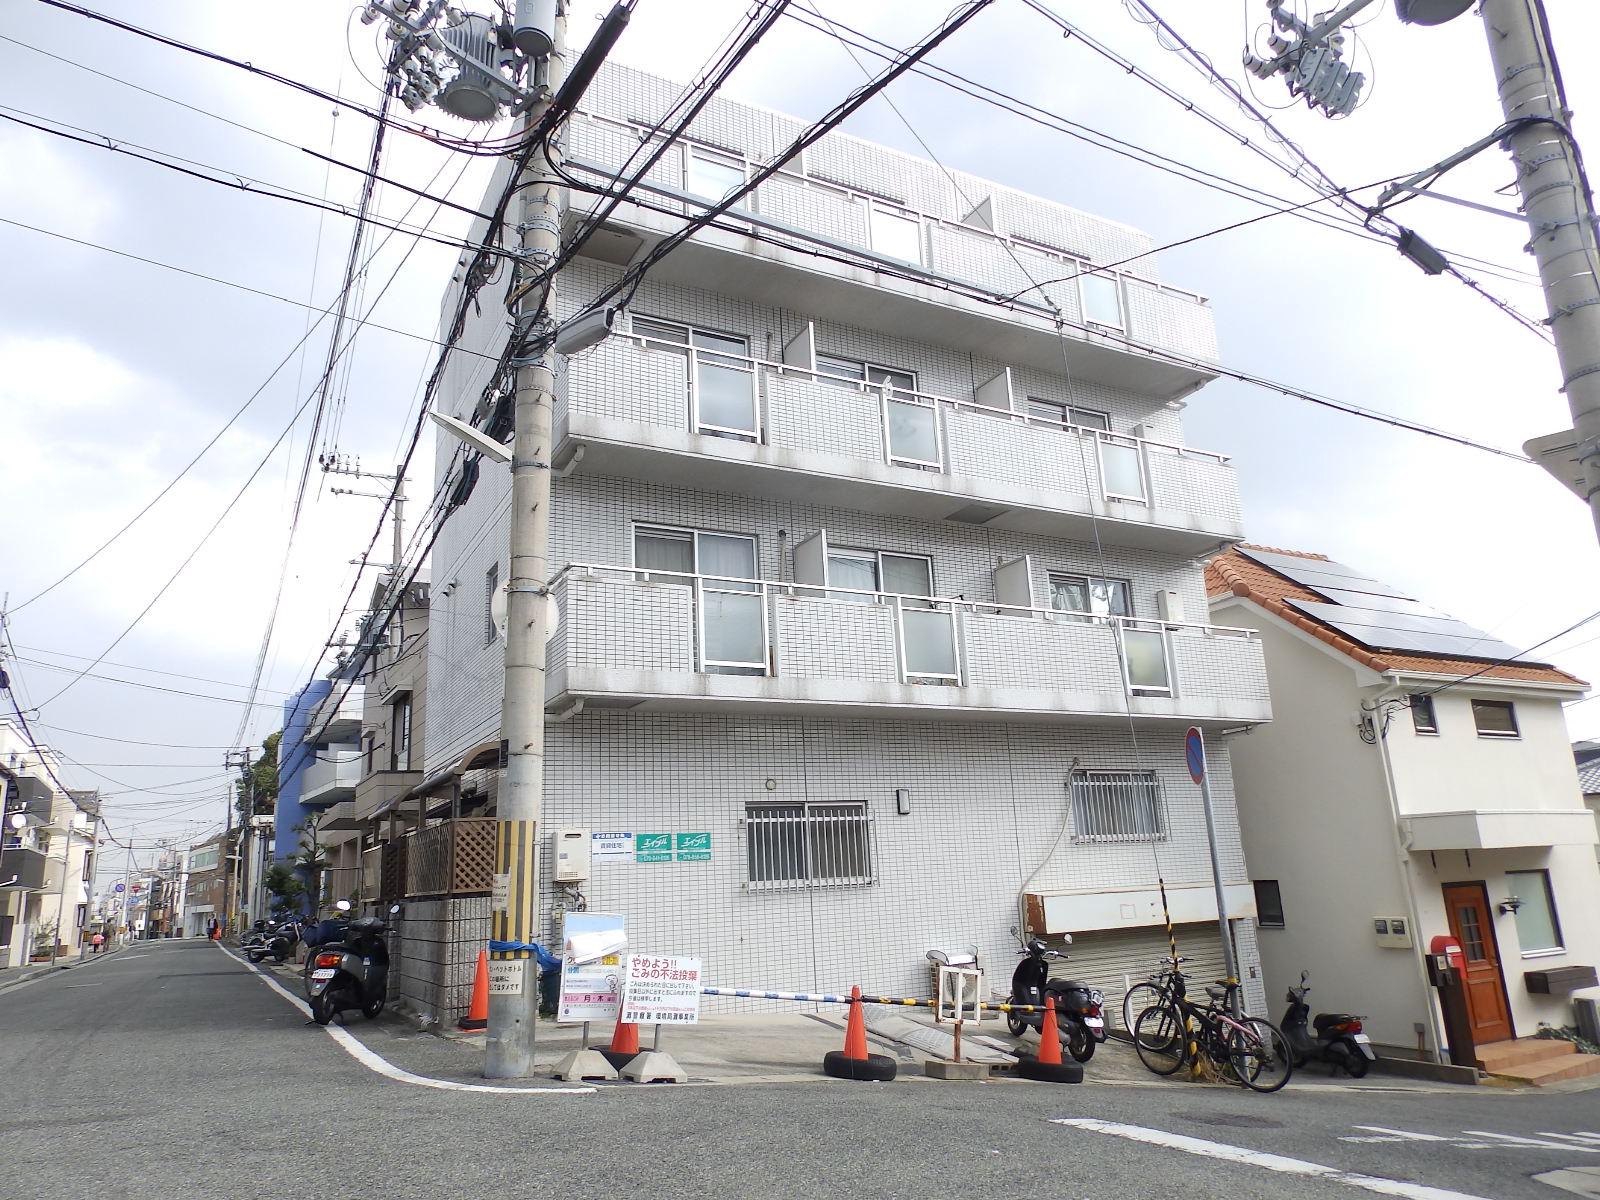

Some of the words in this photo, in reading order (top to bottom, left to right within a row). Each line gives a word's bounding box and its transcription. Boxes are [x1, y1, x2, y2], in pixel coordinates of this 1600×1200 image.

[641, 834, 668, 849] エイブル
[681, 833, 707, 848] エイブル
[631, 967, 698, 981] ごみの不法投棄
